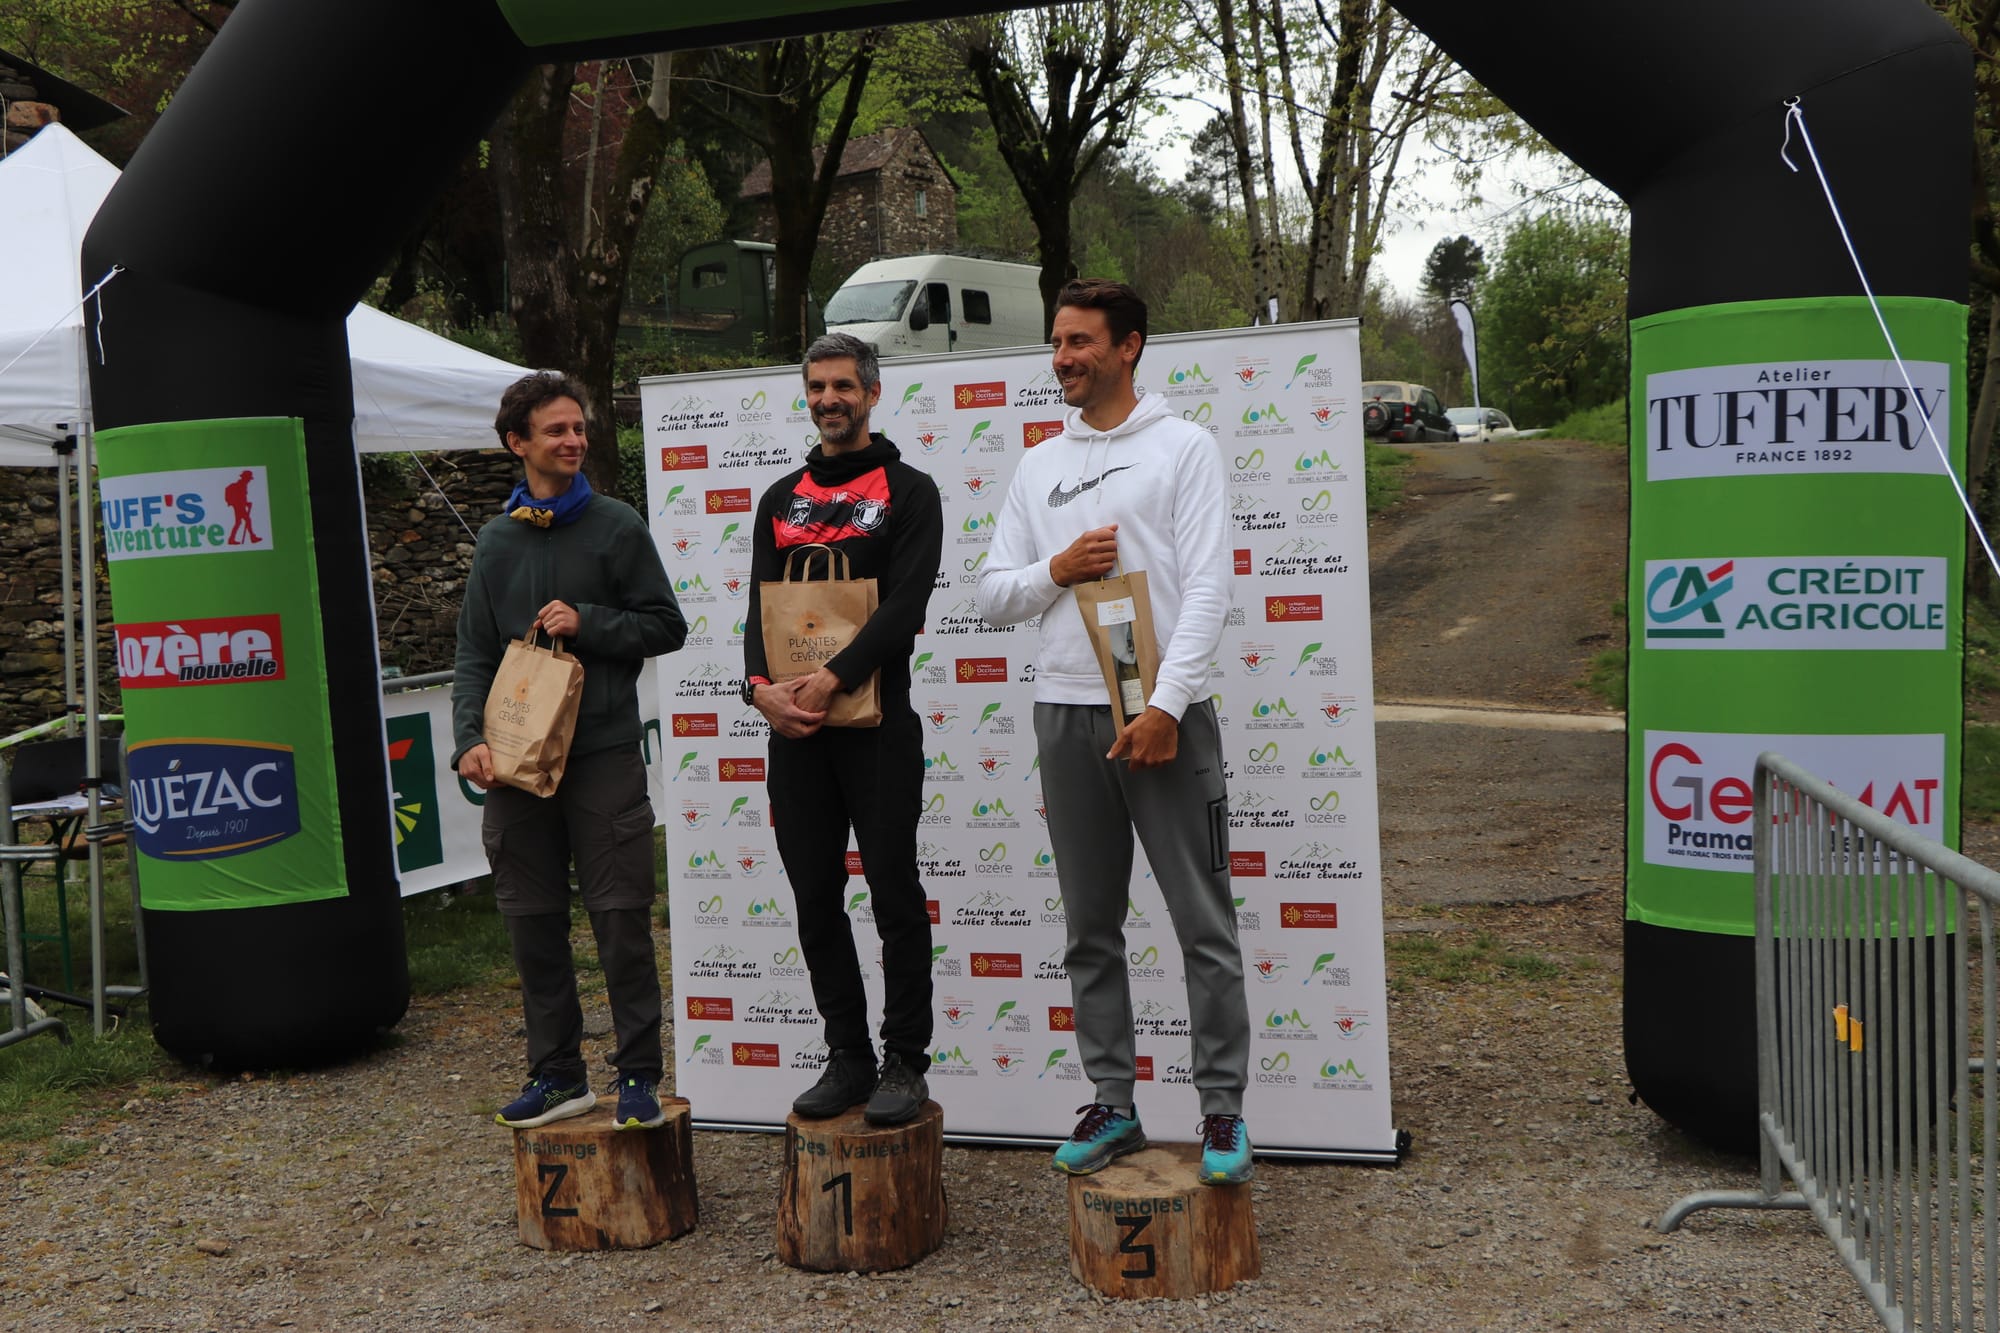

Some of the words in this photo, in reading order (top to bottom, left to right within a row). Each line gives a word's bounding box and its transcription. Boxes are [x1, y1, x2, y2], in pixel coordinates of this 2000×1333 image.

[1757, 368, 1831, 383] Atelier
[1018, 388, 1062, 398] Challeng
[1014, 398, 1048, 408] vallées
[661, 412, 704, 425] Challenge
[736, 410, 772, 422] lozère
[657, 422, 686, 431] vallées
[691, 419, 729, 429] cévenoles
[723, 448, 767, 461] Challenge
[772, 447, 787, 455] des
[1736, 450, 1806, 463] FRANCE
[1815, 449, 1853, 461] 1892
[719, 458, 748, 468] vallées
[754, 456, 792, 466] cévenoles
[1229, 470, 1271, 483] lozère
[1263, 512, 1281, 520] des
[1296, 511, 1338, 524] lozère
[1242, 522, 1286, 531] cévenoles
[1265, 555, 1318, 569] Challenge
[1259, 566, 1296, 576] vallées
[1302, 564, 1348, 574] cévenoles
[960, 574, 976, 584] loz
[1768, 562, 1925, 595] CRÉDIT
[940, 617, 984, 626] Challeng
[1736, 603, 1944, 631] AGRICOLE
[935, 625, 968, 634] vallées
[789, 637, 837, 648] PLANTES
[179, 657, 277, 681] nouvelle
[679, 679, 722, 690] Challenge
[675, 688, 704, 696] vallées
[710, 688, 741, 696] cévenole
[728, 730, 758, 738] vallées
[1243, 763, 1285, 775] lozère
[130, 759, 282, 834] QUÉZAC
[918, 814, 952, 824] ozère
[1272, 810, 1289, 818] des
[1304, 812, 1347, 824] lozère
[1250, 819, 1295, 828] cévenoles
[186, 825, 220, 842] Depuis
[224, 818, 249, 834] 1901
[974, 862, 1013, 873] lozère
[1279, 860, 1332, 872] Challenge
[926, 868, 966, 877] cévenoles
[1273, 870, 1310, 878] vallées
[1317, 871, 1363, 879] cévenoles
[956, 908, 1004, 919] Challenge
[693, 914, 729, 925] lozère
[951, 917, 984, 925] vallées
[990, 918, 1032, 926] cévenoles
[693, 960, 737, 971] Challenge
[689, 969, 718, 977] vallées
[724, 970, 762, 978] cévenoles
[768, 966, 805, 977] lozère
[1034, 972, 1068, 980] vallées
[1128, 966, 1165, 978] ozère
[748, 1005, 792, 1017] Challenge
[744, 1014, 774, 1023] vallées
[779, 1016, 818, 1024] cévenoles
[1170, 1018, 1188, 1026] des
[790, 1061, 822, 1070] vallées
[1255, 1072, 1297, 1084] lozère
[517, 1136, 597, 1159] Challenge
[795, 1134, 826, 1156] Des
[840, 1139, 910, 1159] Vallées
[822, 1172, 853, 1236] 1
[1084, 1191, 1184, 1215] Cévenoles
[1115, 1215, 1156, 1279] 3
